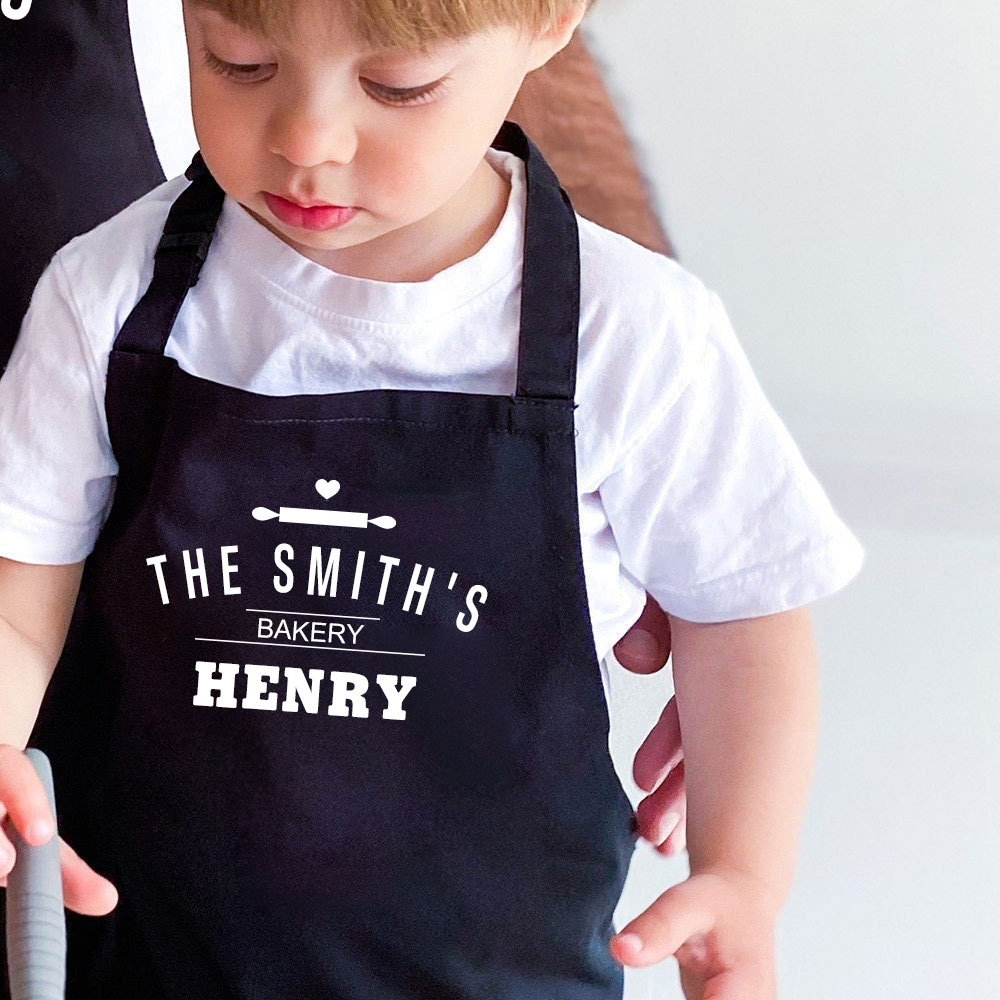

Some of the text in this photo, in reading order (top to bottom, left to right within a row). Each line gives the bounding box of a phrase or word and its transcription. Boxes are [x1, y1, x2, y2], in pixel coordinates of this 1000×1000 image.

[145, 542, 489, 633] THE SMITH'S
[257, 617, 365, 645] BAKERY
[192, 660, 417, 721] HENRY
